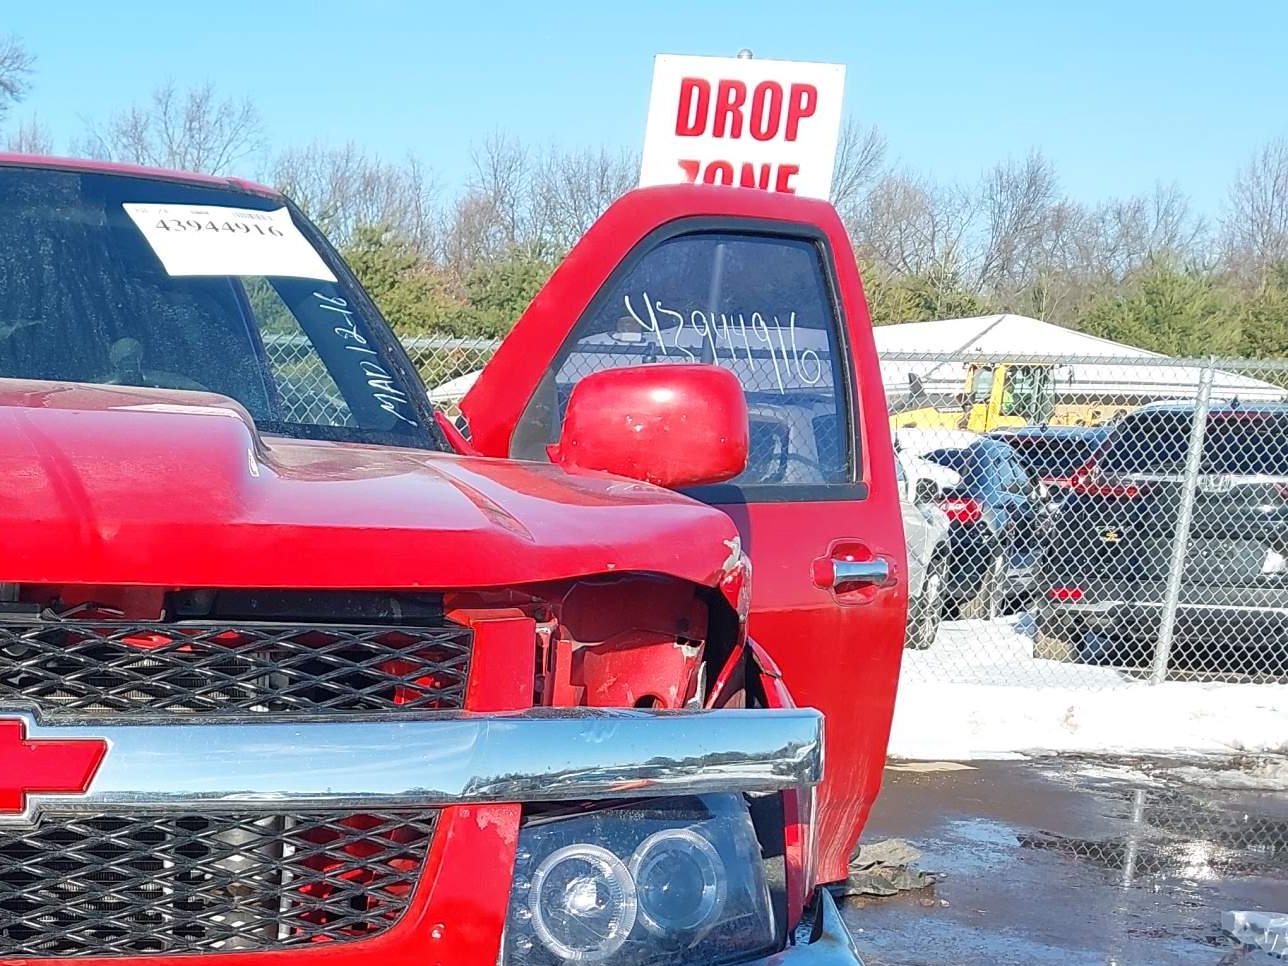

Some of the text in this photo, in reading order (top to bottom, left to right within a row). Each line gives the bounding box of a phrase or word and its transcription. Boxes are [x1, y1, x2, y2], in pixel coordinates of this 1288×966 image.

[674, 76, 818, 142] DROP
[155, 218, 284, 238] 43944916
[623, 290, 821, 395] 43944916
